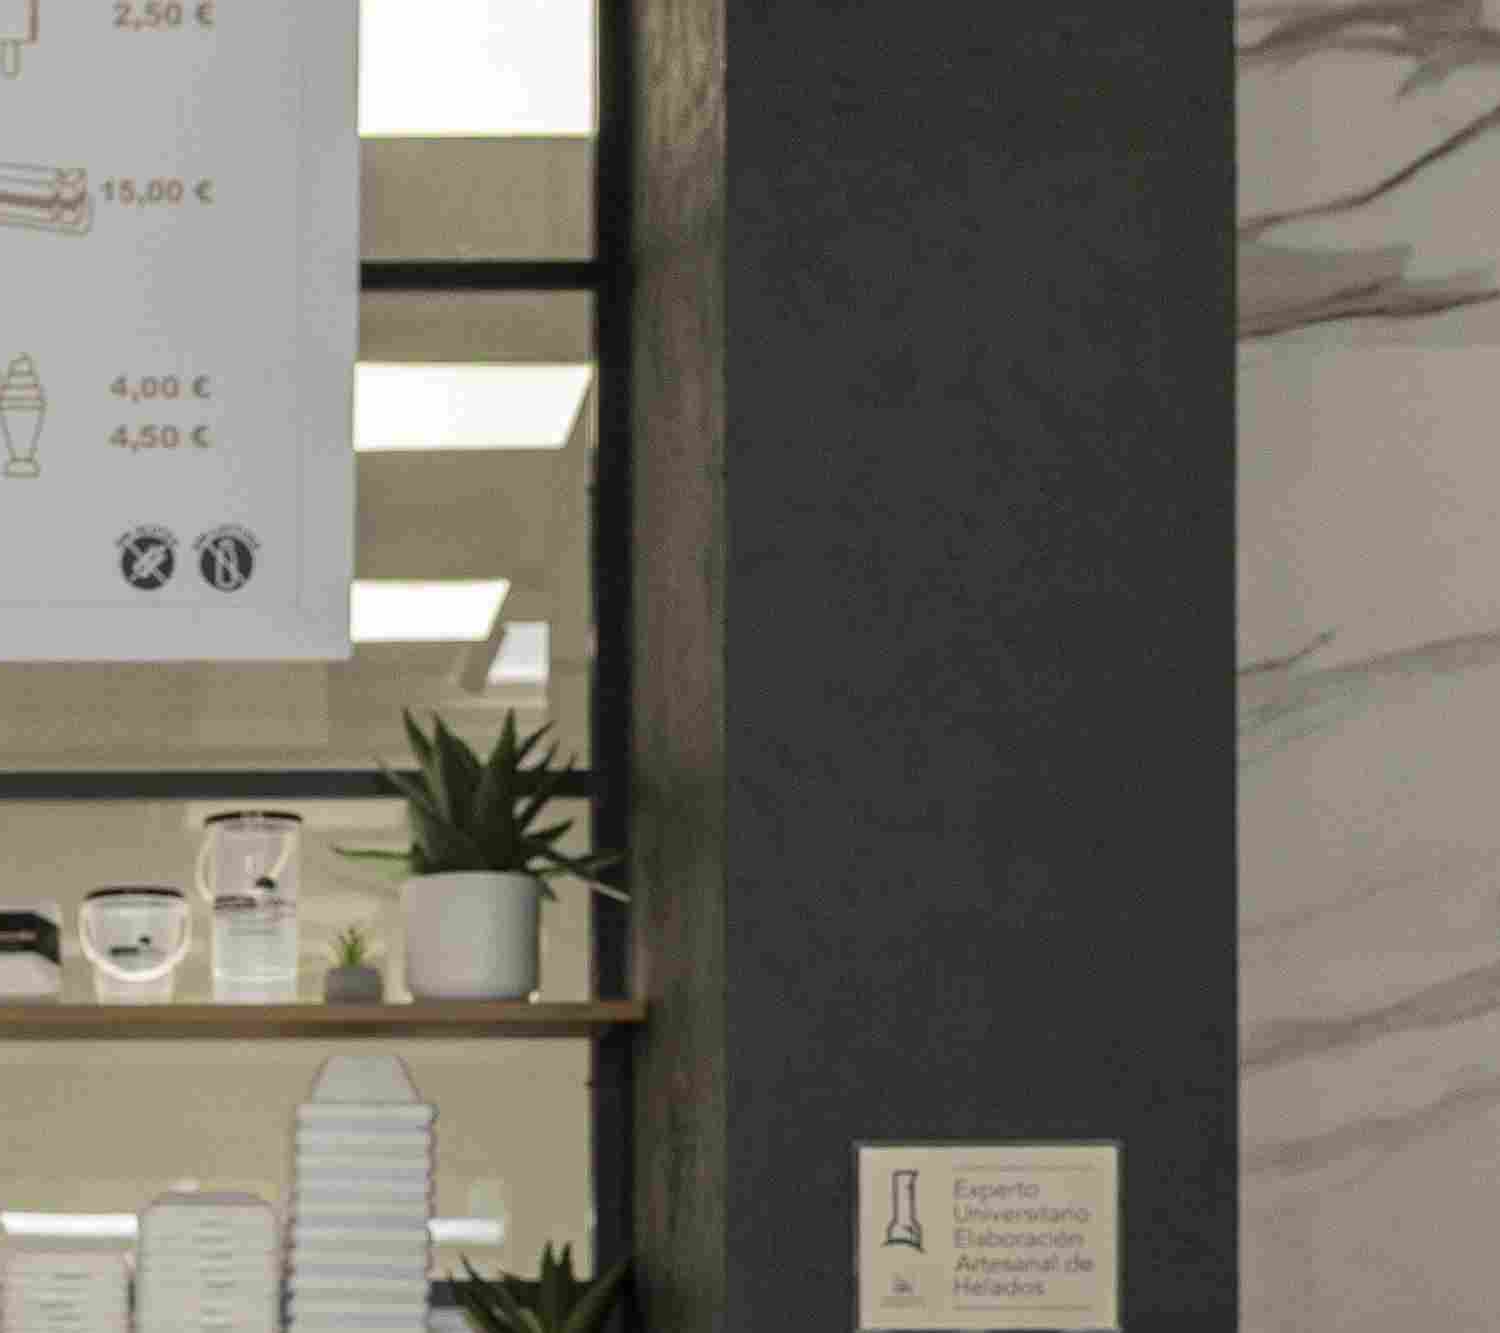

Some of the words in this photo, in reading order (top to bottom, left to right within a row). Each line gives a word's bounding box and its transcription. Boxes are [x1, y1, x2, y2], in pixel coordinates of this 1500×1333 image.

[194, 178, 214, 203] €
[110, 375, 180, 402] 4,00
[192, 375, 212, 399] €
[190, 424, 211, 448] €
[953, 1178, 1040, 1202] Experto
[1063, 1253, 1095, 1273] de
[953, 1277, 1046, 1298] Helados
